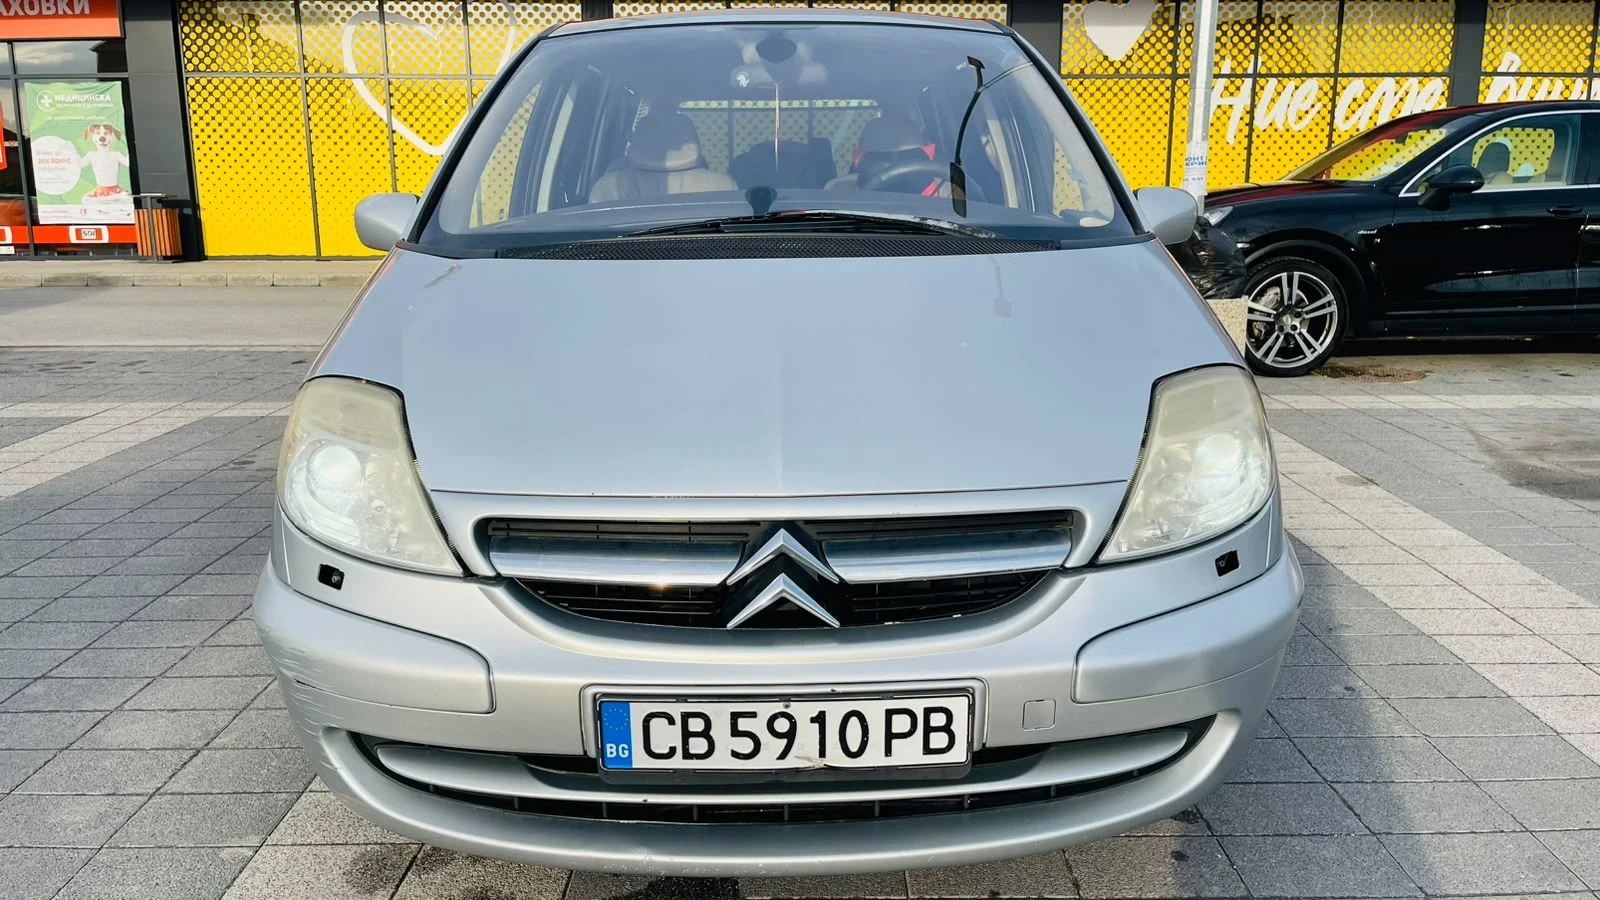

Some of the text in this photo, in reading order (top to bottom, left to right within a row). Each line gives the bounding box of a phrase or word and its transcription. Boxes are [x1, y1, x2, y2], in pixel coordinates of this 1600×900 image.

[606, 743, 630, 758] BG
[641, 706, 956, 761] CB 5910 PB
